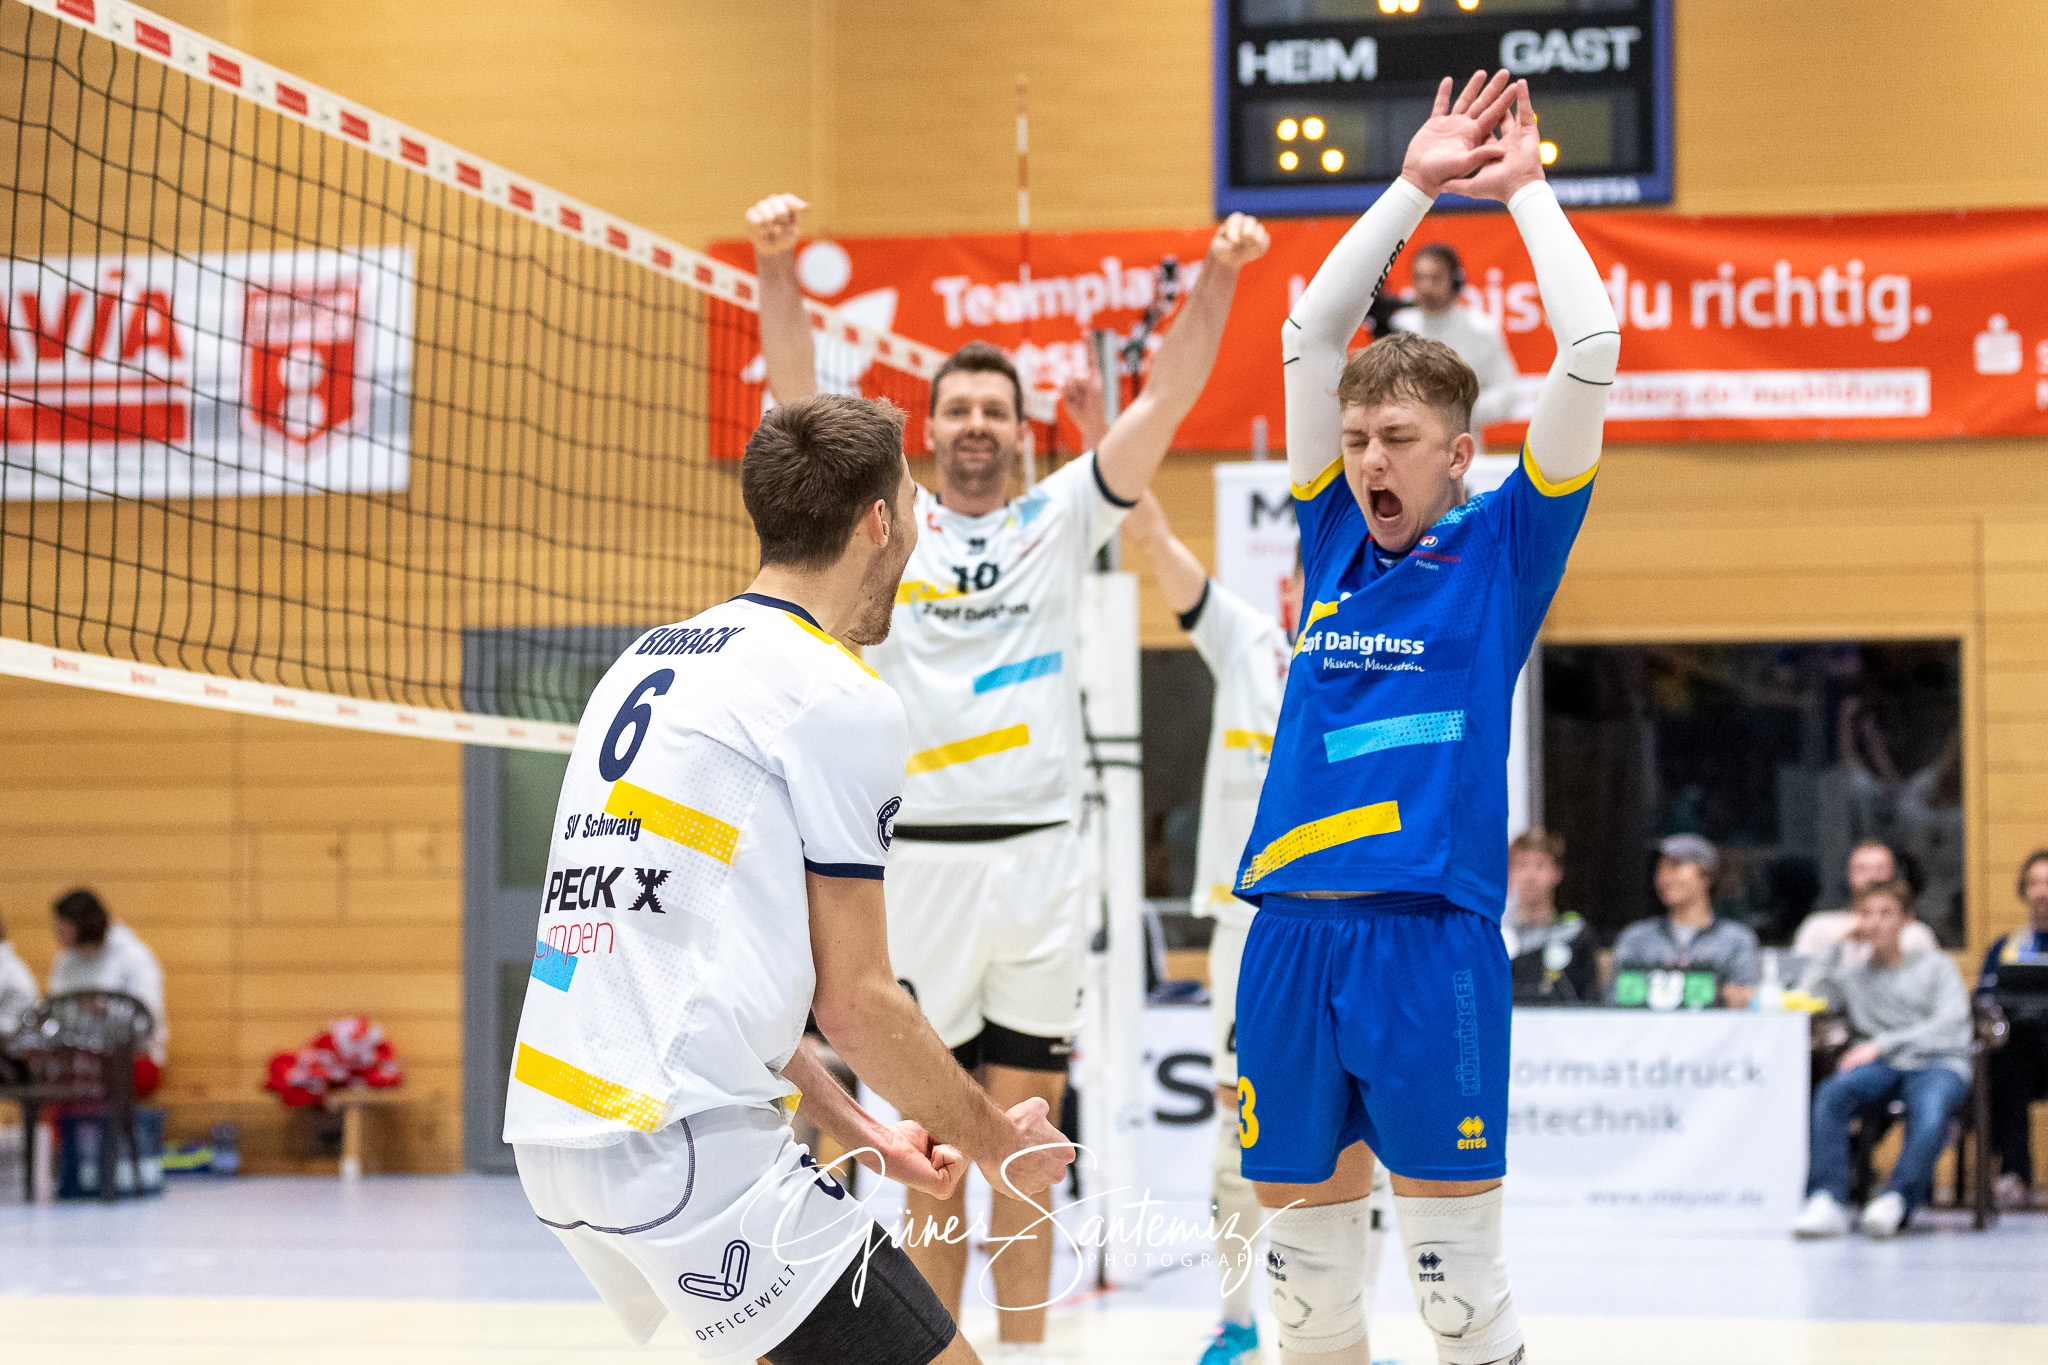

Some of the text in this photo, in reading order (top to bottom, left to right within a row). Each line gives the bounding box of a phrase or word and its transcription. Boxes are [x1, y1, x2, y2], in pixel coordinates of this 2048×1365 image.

[1238, 36, 1378, 85] HEIM
[1501, 26, 1641, 75] GAST
[1691, 259, 1932, 342] richtig.
[952, 561, 999, 594] 10
[634, 627, 746, 656] BIBRACK
[1325, 631, 1425, 655] Daigfuss
[598, 668, 676, 783] 6
[564, 811, 642, 842] SV Schwaig
[544, 865, 625, 914] PECK
[695, 1264, 796, 1341] OFFICEWELT
